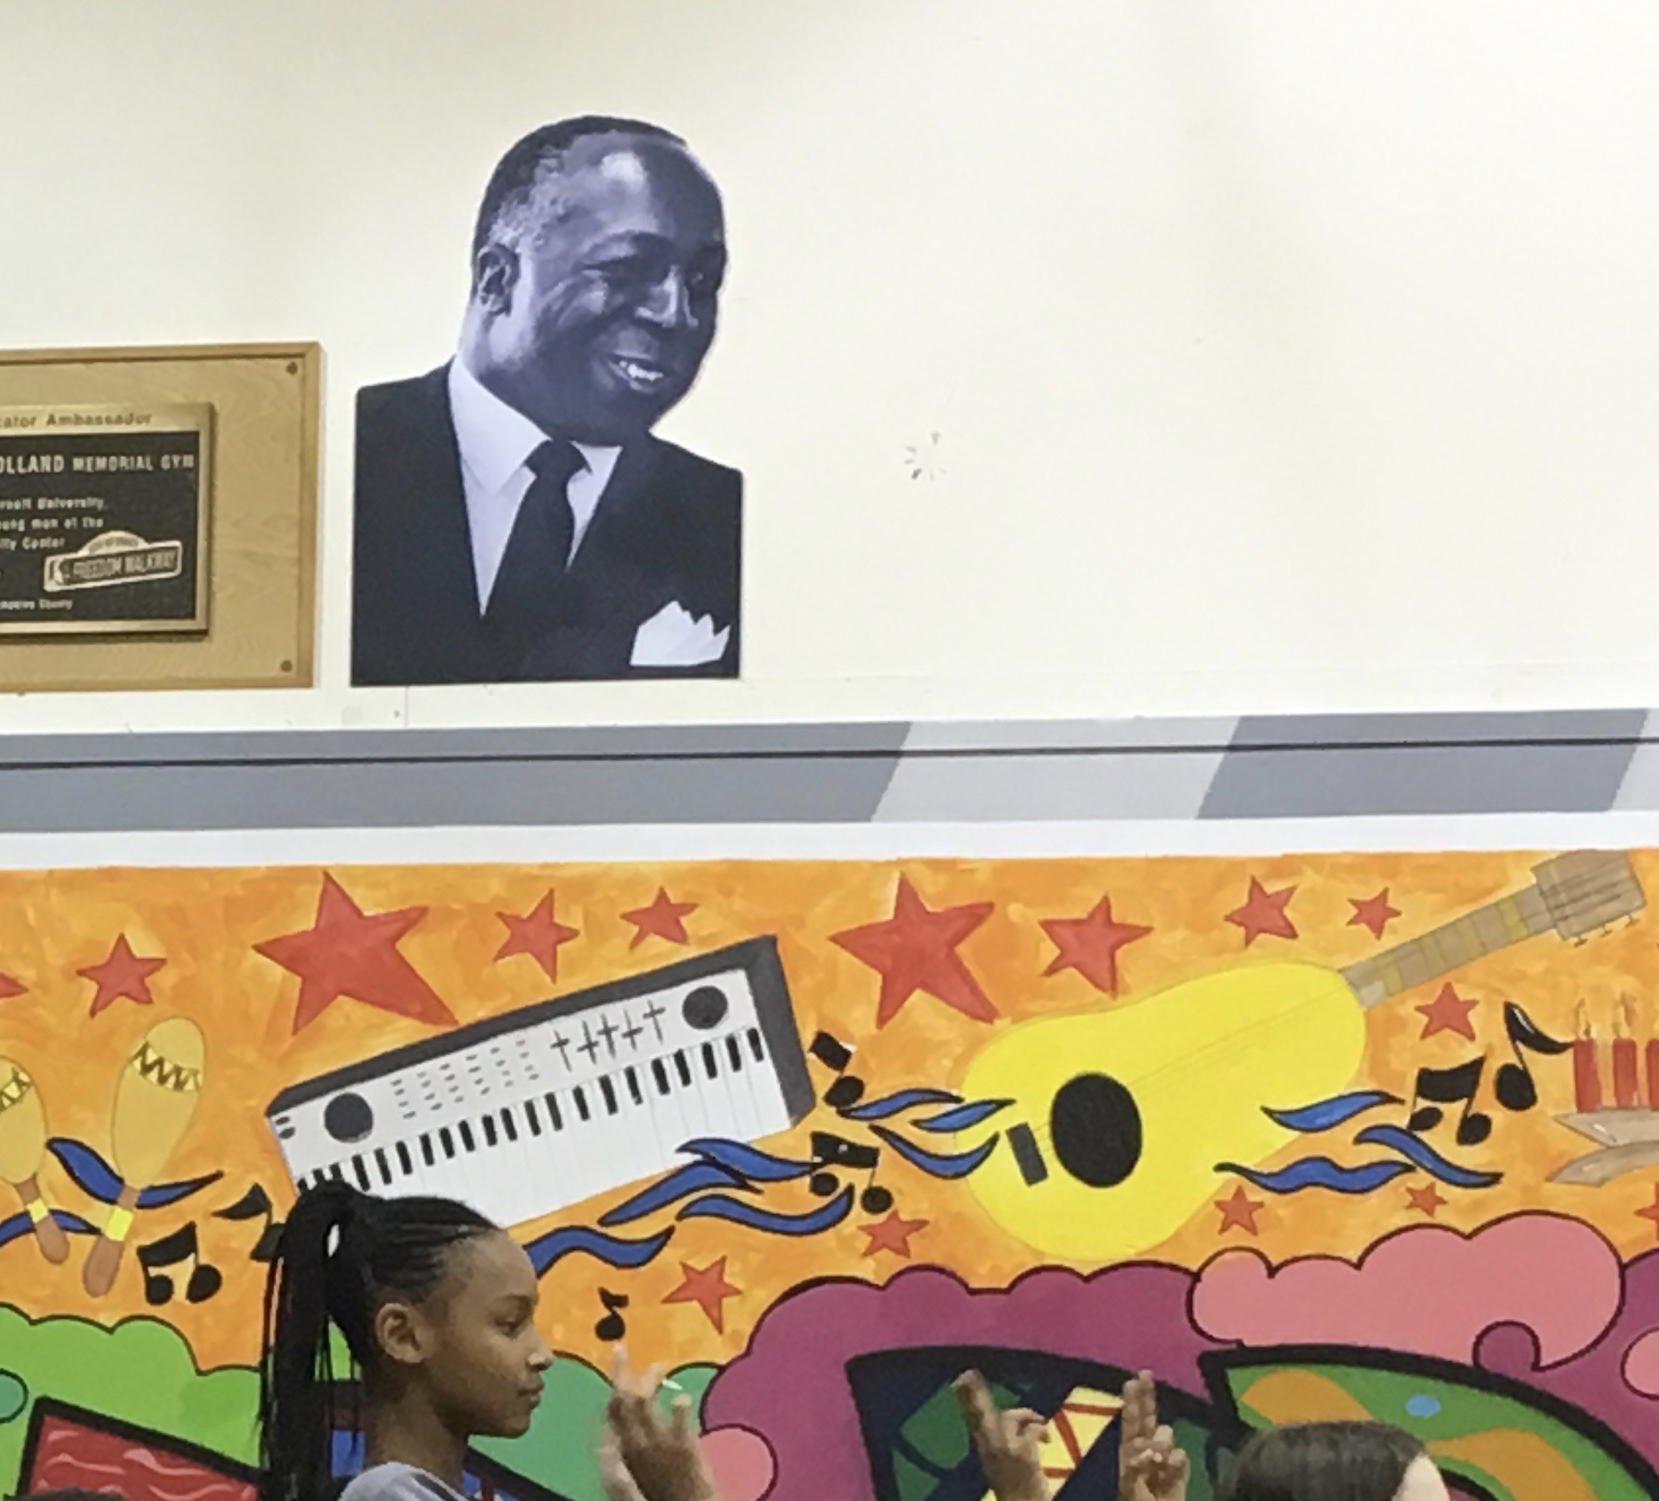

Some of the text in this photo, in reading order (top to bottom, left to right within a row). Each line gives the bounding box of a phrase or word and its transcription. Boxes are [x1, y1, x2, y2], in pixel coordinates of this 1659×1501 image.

[46, 412, 153, 426] Ambassador
[73, 455, 154, 472] MEMORIAL
[160, 454, 195, 471] GYM
